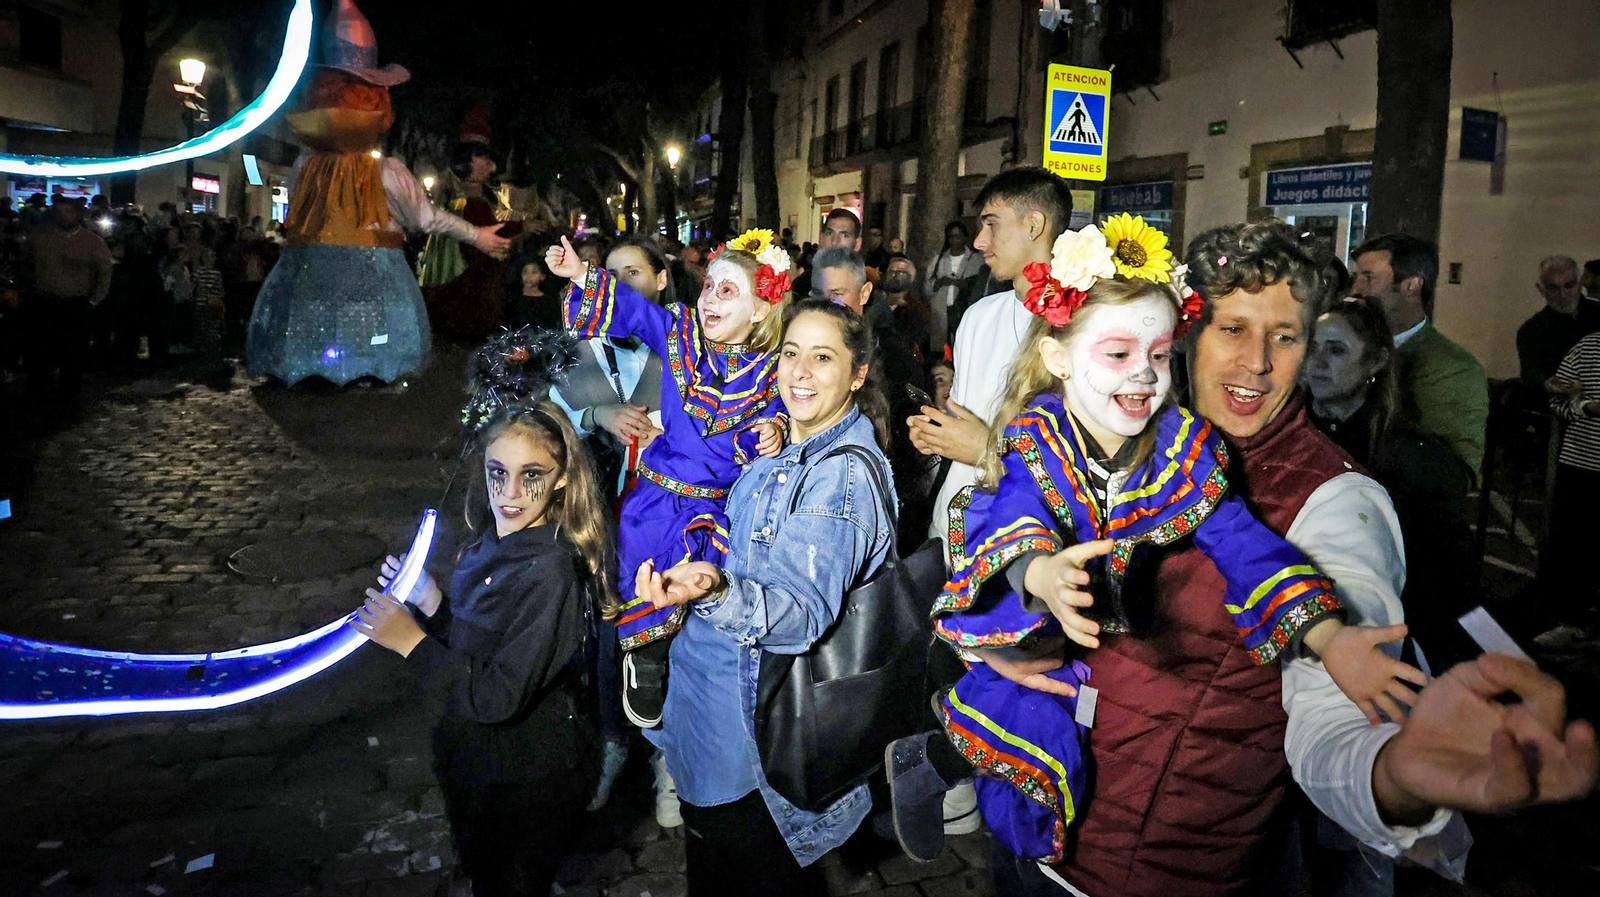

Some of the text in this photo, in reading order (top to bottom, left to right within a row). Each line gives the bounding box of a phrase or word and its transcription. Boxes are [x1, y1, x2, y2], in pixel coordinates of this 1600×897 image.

[1054, 72, 1106, 86] ATENCIÓN
[1048, 160, 1102, 173] PEATONES
[1272, 173, 1298, 184] Libros
[1301, 169, 1343, 182] infantiles
[1346, 170, 1352, 181] y
[1273, 188, 1318, 203] Juegos
